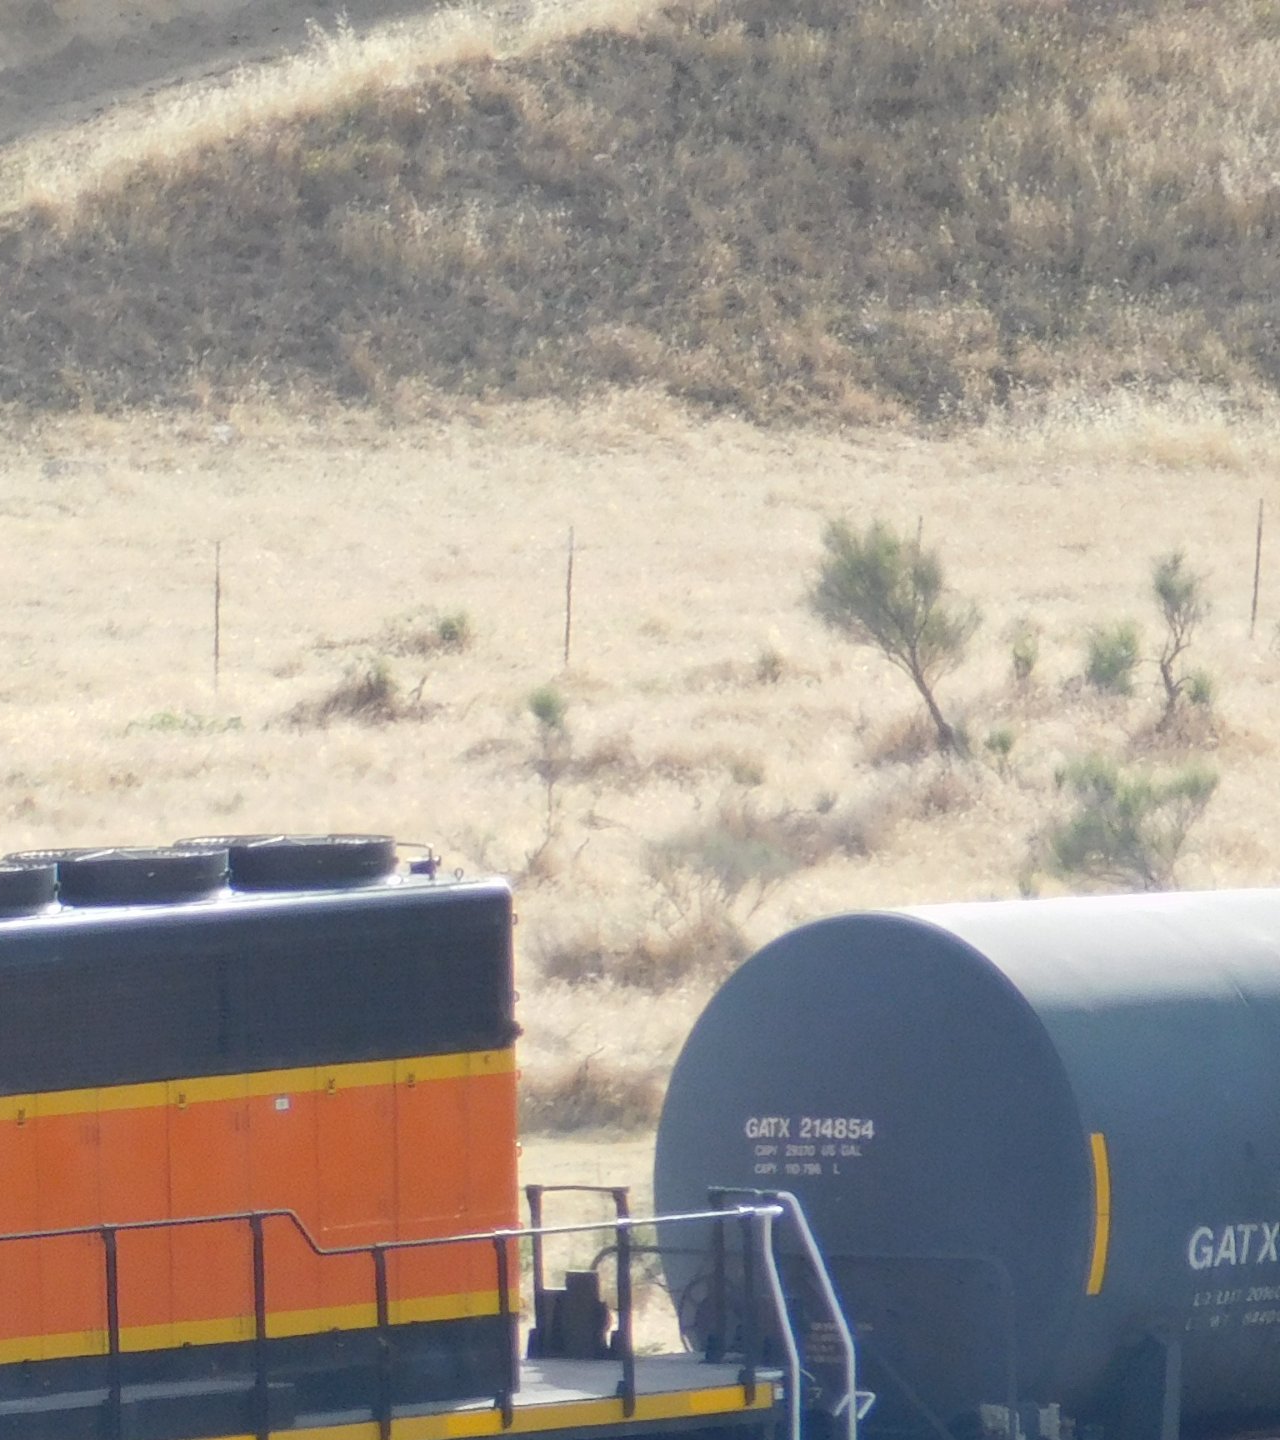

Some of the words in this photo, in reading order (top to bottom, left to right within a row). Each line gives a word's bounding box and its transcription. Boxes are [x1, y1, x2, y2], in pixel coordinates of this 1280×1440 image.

[745, 1117, 790, 1138] GATX
[800, 1117, 874, 1139] 214854
[1188, 1222, 1280, 1271] GATX
